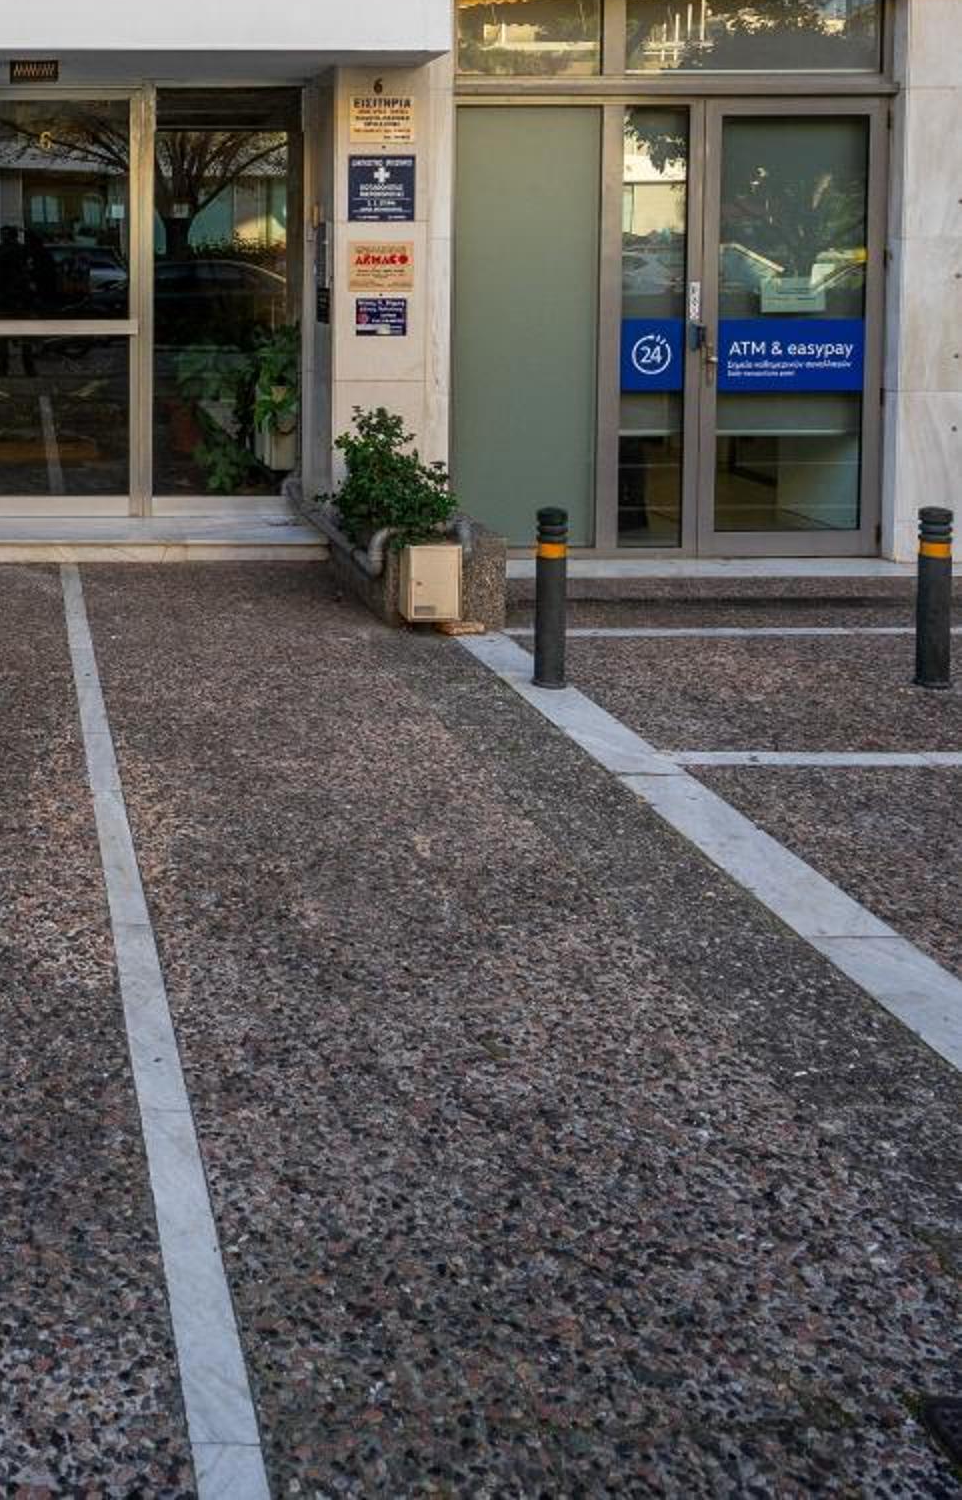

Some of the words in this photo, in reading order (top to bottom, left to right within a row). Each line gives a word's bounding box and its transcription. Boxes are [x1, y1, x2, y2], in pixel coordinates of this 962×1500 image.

[373, 78, 383, 94] 6
[639, 346, 662, 364] 24
[729, 341, 767, 356] ATM
[771, 340, 784, 356] &
[787, 342, 854, 359] easypay
